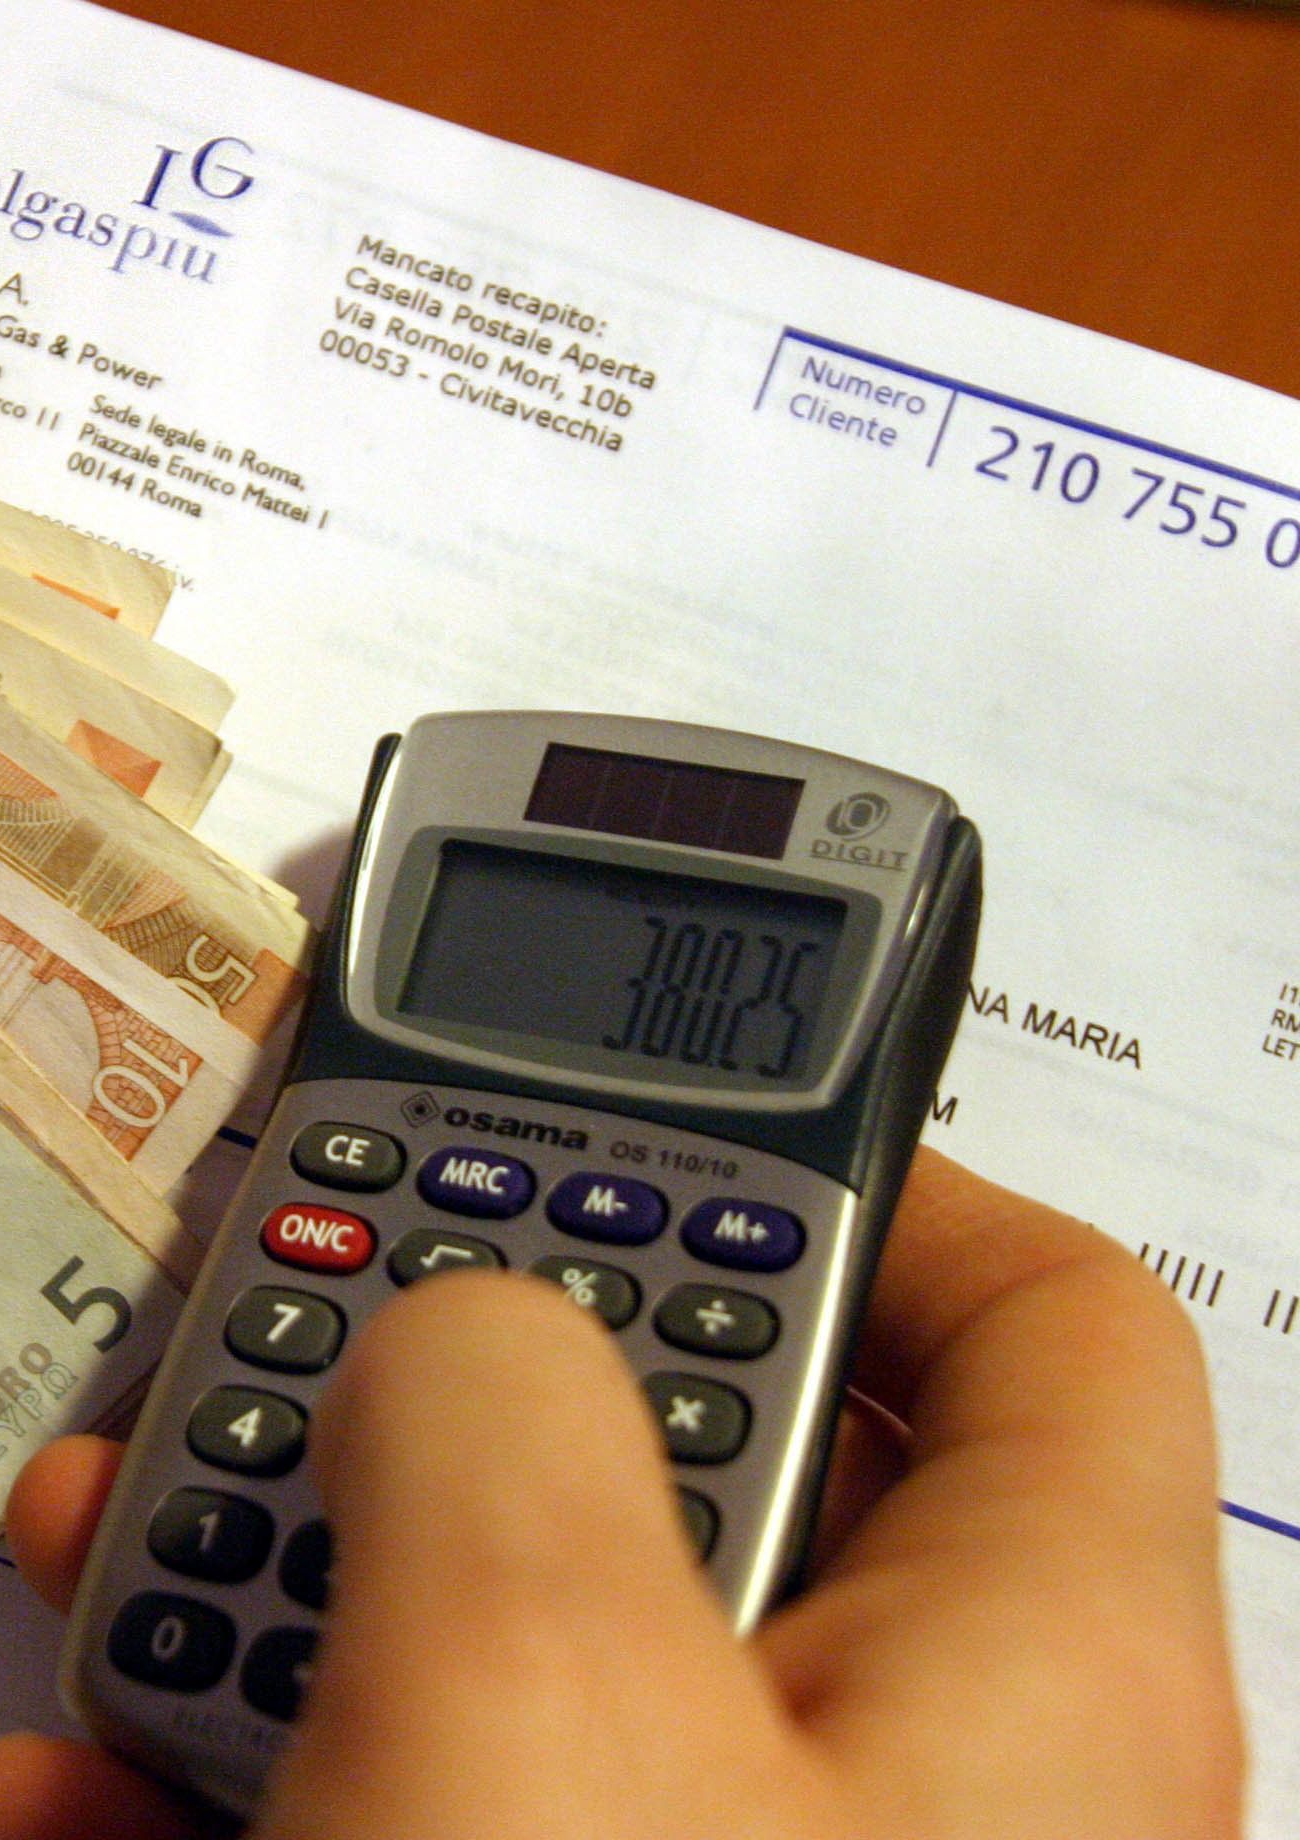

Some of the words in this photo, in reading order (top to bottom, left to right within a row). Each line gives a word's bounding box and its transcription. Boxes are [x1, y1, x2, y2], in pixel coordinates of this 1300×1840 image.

[356, 233, 473, 292] Mancato
[482, 280, 608, 338] recapito:
[334, 296, 375, 330] Via
[385, 317, 490, 370] Romolo
[498, 357, 566, 401] Mori,
[578, 384, 633, 419] 10b
[345, 266, 442, 318] Casella
[451, 302, 553, 356] Postale
[560, 342, 658, 390] Aperta
[48, 334, 68, 358] &
[77, 344, 163, 390] Power
[319, 329, 410, 378] 00053
[439, 371, 625, 452] Civitavecchia
[800, 355, 927, 416] Numero
[89, 394, 141, 427] Sede
[147, 409, 206, 455] legale
[212, 436, 233, 462] in
[788, 393, 898, 448] Cliente
[67, 451, 135, 492] 00144
[140, 482, 203, 520] Roma
[78, 423, 161, 470] Piazzale
[166, 456, 236, 497] Enrico
[241, 483, 310, 524] Mattei
[974, 425, 1100, 504] 210
[1123, 468, 1247, 549] 755
[811, 839, 908, 869] DIGIT
[1022, 1003, 1141, 1070] MARIA
[92, 1038, 191, 1128] 10
[325, 1135, 365, 1167] CE
[443, 1105, 589, 1152] osama
[609, 1138, 648, 1164] OS
[657, 1148, 737, 1181] 110/10
[440, 1158, 509, 1195] MRC
[582, 1187, 628, 1216] M-
[279, 1214, 354, 1253] ON/C
[714, 1210, 768, 1242] M+
[41, 1255, 132, 1354] 5
[267, 1303, 301, 1344] 7
[229, 1407, 262, 1448] 4
[199, 1512, 218, 1549] 1
[152, 1616, 185, 1659] 0
